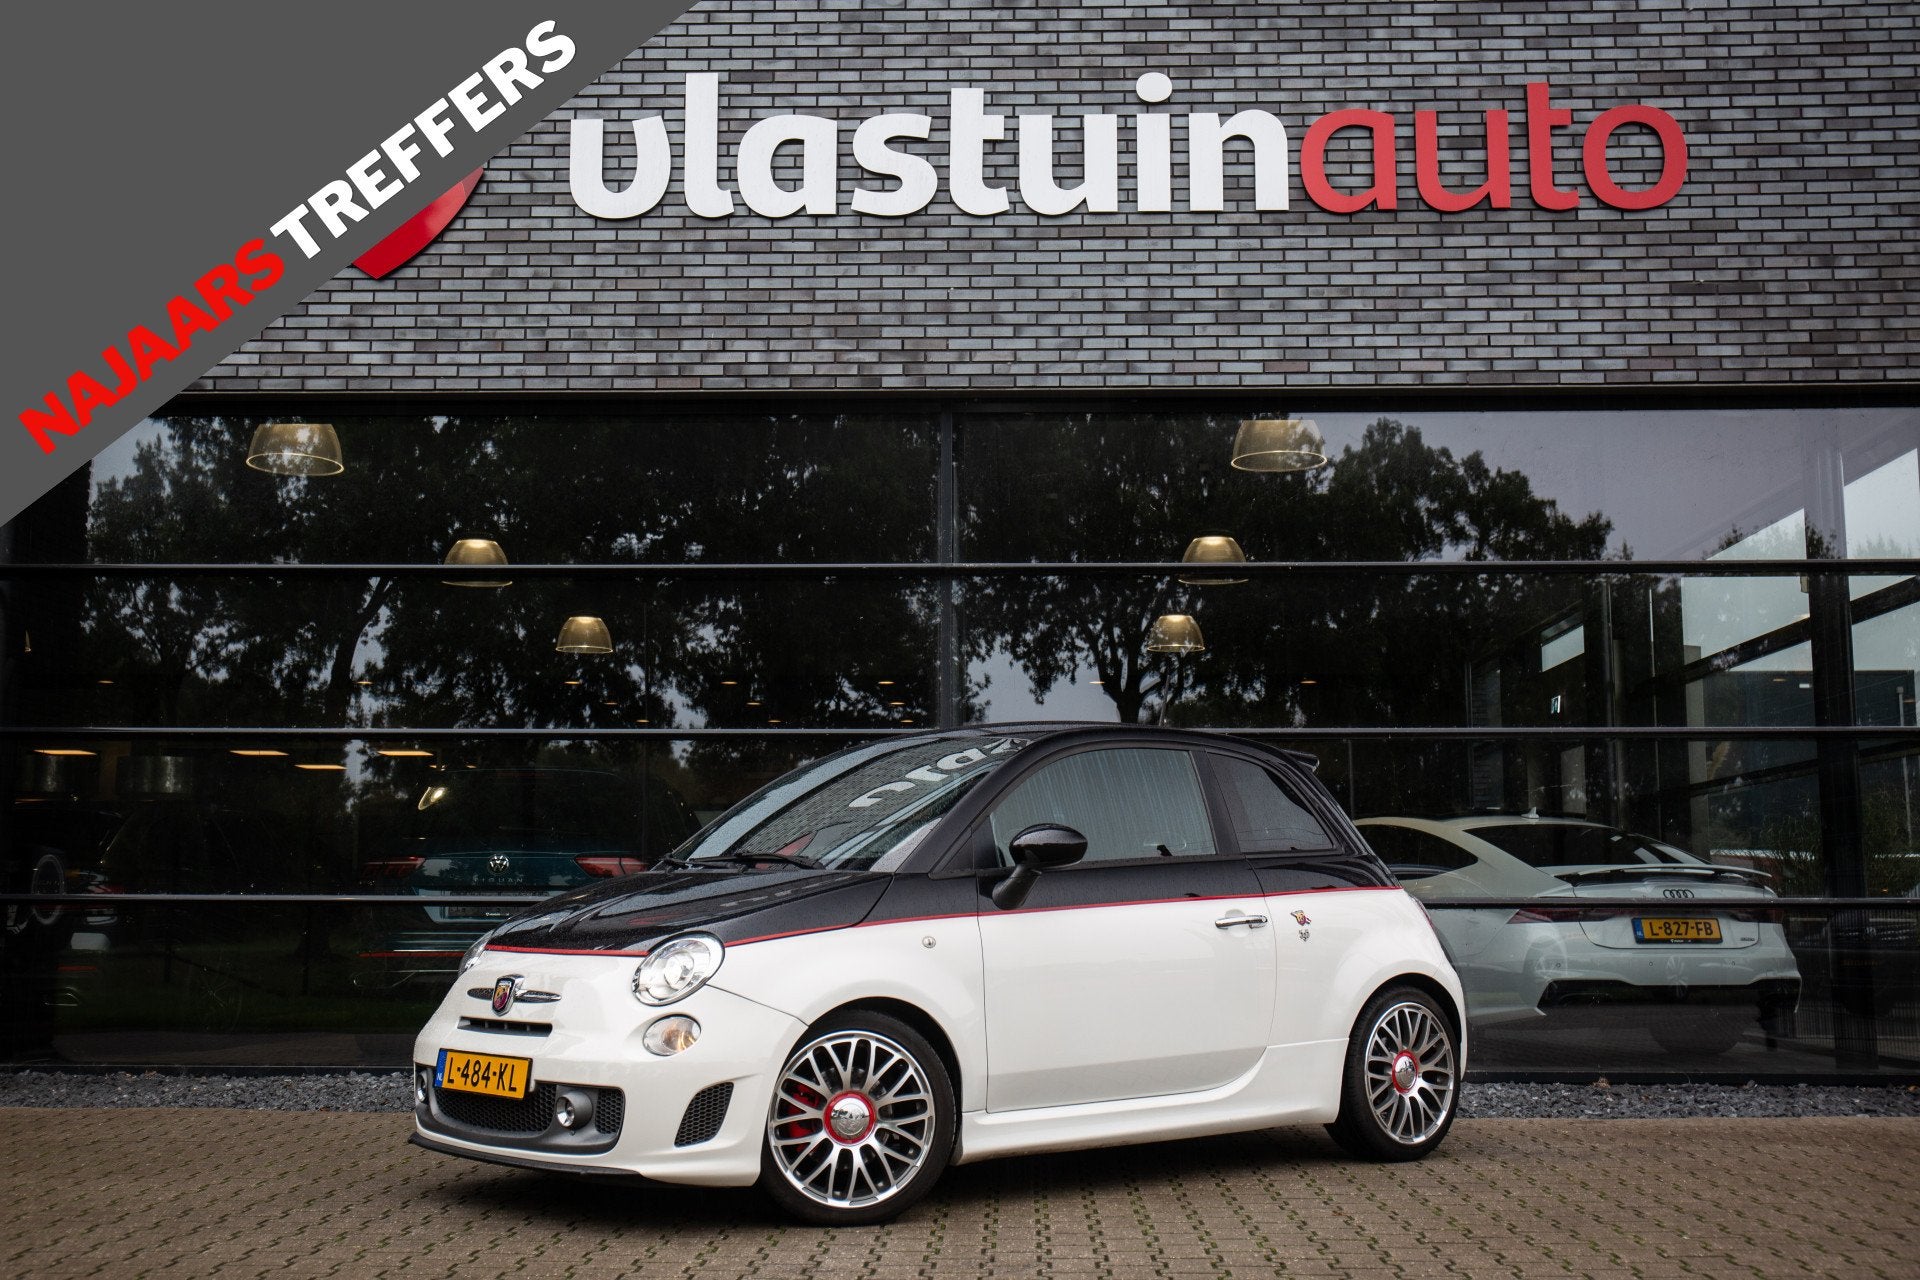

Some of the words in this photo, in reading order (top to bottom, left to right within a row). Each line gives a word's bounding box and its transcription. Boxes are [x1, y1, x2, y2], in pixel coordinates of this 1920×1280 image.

[1648, 921, 1714, 937] L-827-FB
[436, 1072, 443, 1081] NL
[447, 1057, 517, 1092] L-484-KL
